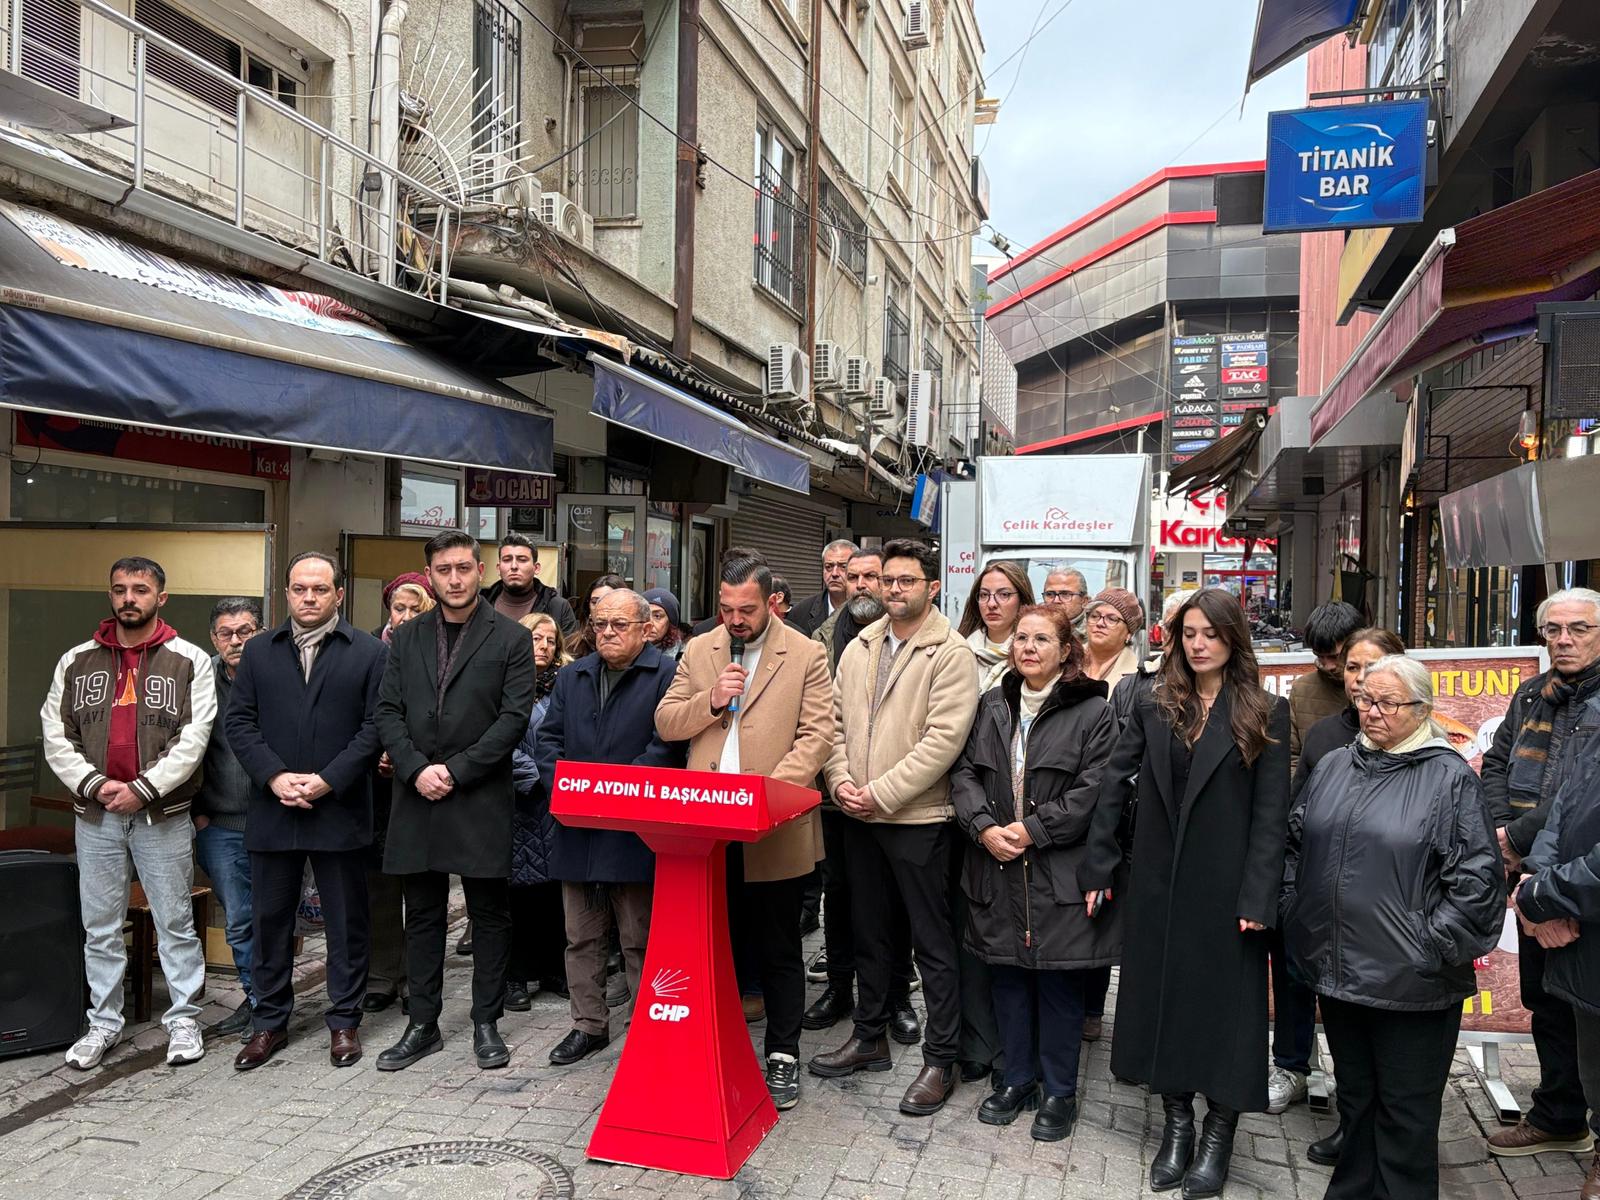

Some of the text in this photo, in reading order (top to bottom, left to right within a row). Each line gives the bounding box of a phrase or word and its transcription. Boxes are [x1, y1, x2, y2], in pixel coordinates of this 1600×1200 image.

[1298, 141, 1396, 172] TİTANİK
[1319, 174, 1370, 198] BAR
[1174, 404, 1213, 413] KARACA
[1222, 416, 1243, 424] PHI
[256, 457, 276, 474] Kat
[495, 474, 548, 500] OCAĞI
[1003, 520, 1114, 532] Çelik Kardeşler
[73, 670, 109, 712] 19
[145, 675, 178, 715] 91
[557, 777, 754, 806] CHP AYDIN İL BAŞKANLIĞI
[649, 1002, 690, 1022] CHP
